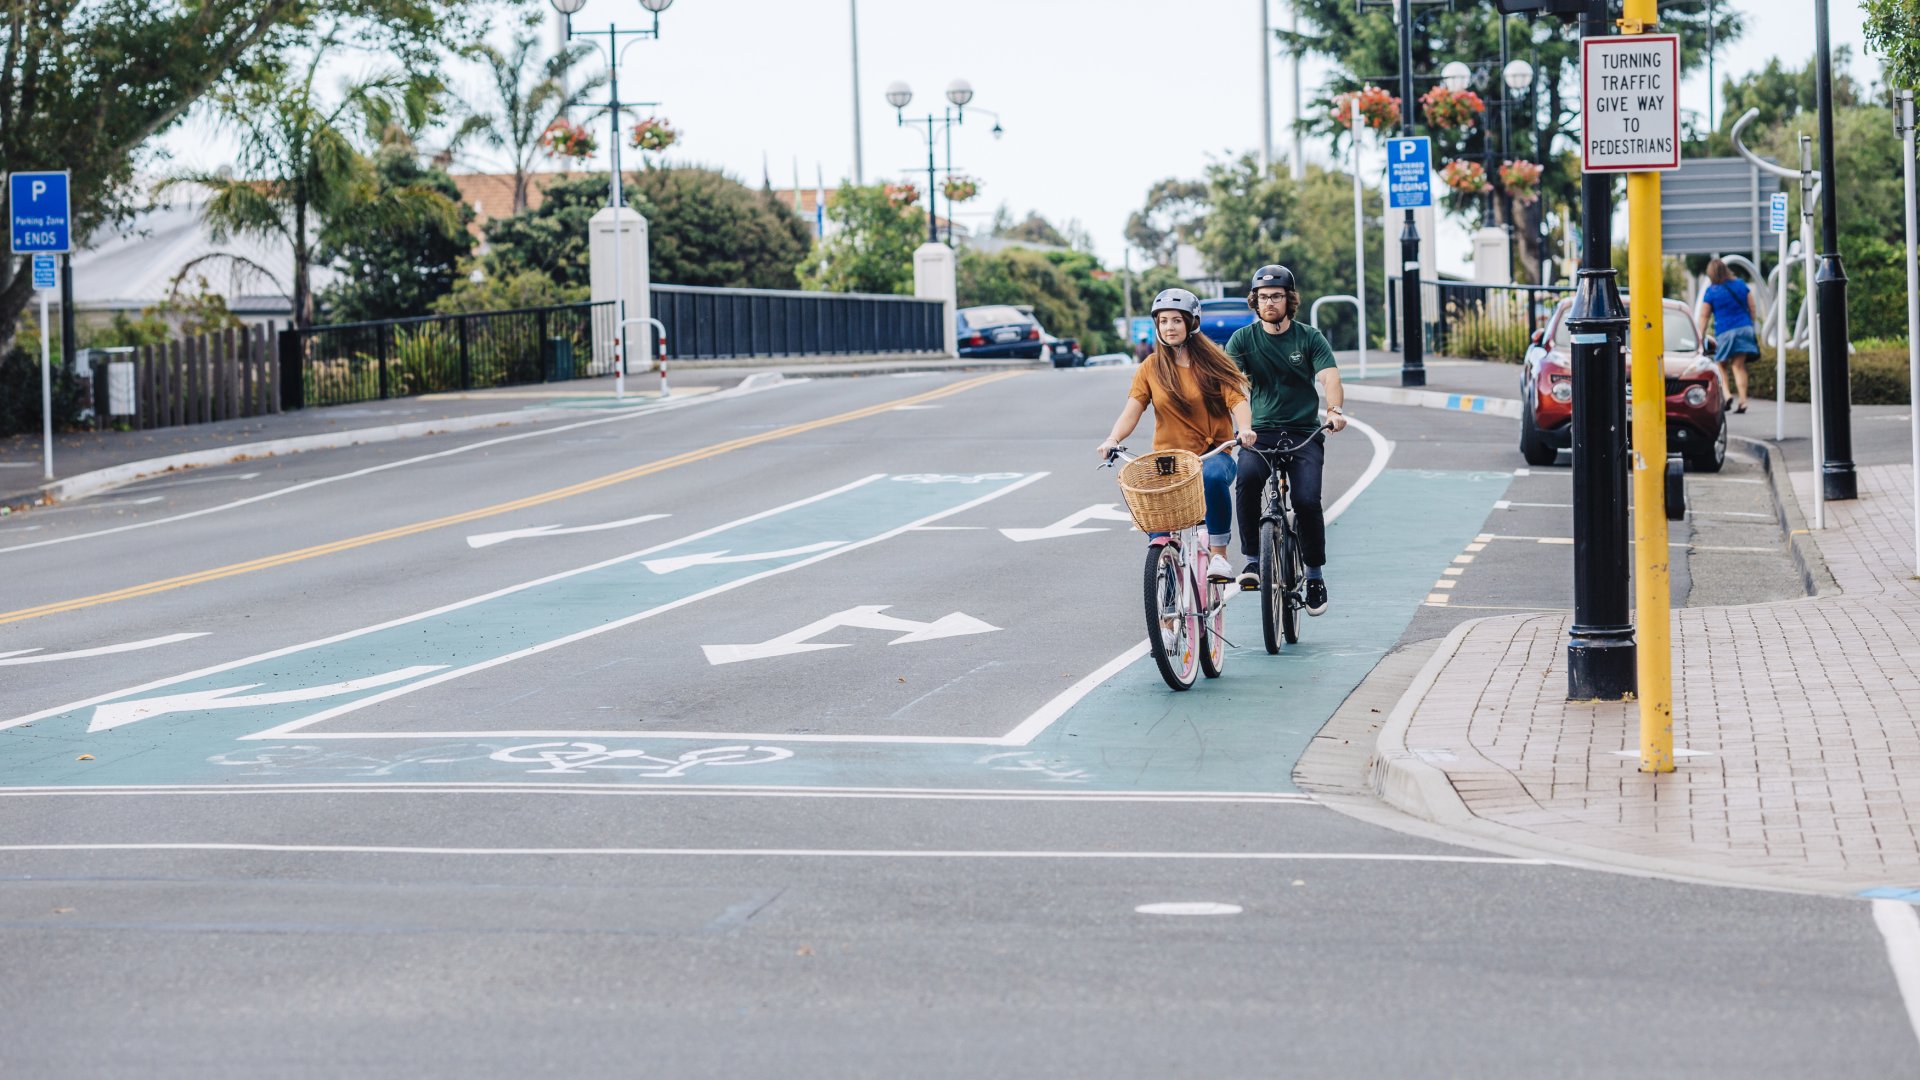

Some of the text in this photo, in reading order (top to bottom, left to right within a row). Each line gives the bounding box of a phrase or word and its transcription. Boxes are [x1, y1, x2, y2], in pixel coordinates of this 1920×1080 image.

[1601, 52, 1661, 69] TURNING
[1601, 74, 1661, 91] TRAFFIC
[1597, 95, 1665, 112] GIVE WAY
[1623, 117, 1640, 133] TO
[1400, 141, 1417, 161] P
[1591, 137, 1672, 155] PEDESTRIANS
[32, 181, 46, 202] P
[1391, 182, 1428, 192] BEGINS
[15, 215, 65, 227] Parking Zone
[25, 232, 56, 245] ENDS
